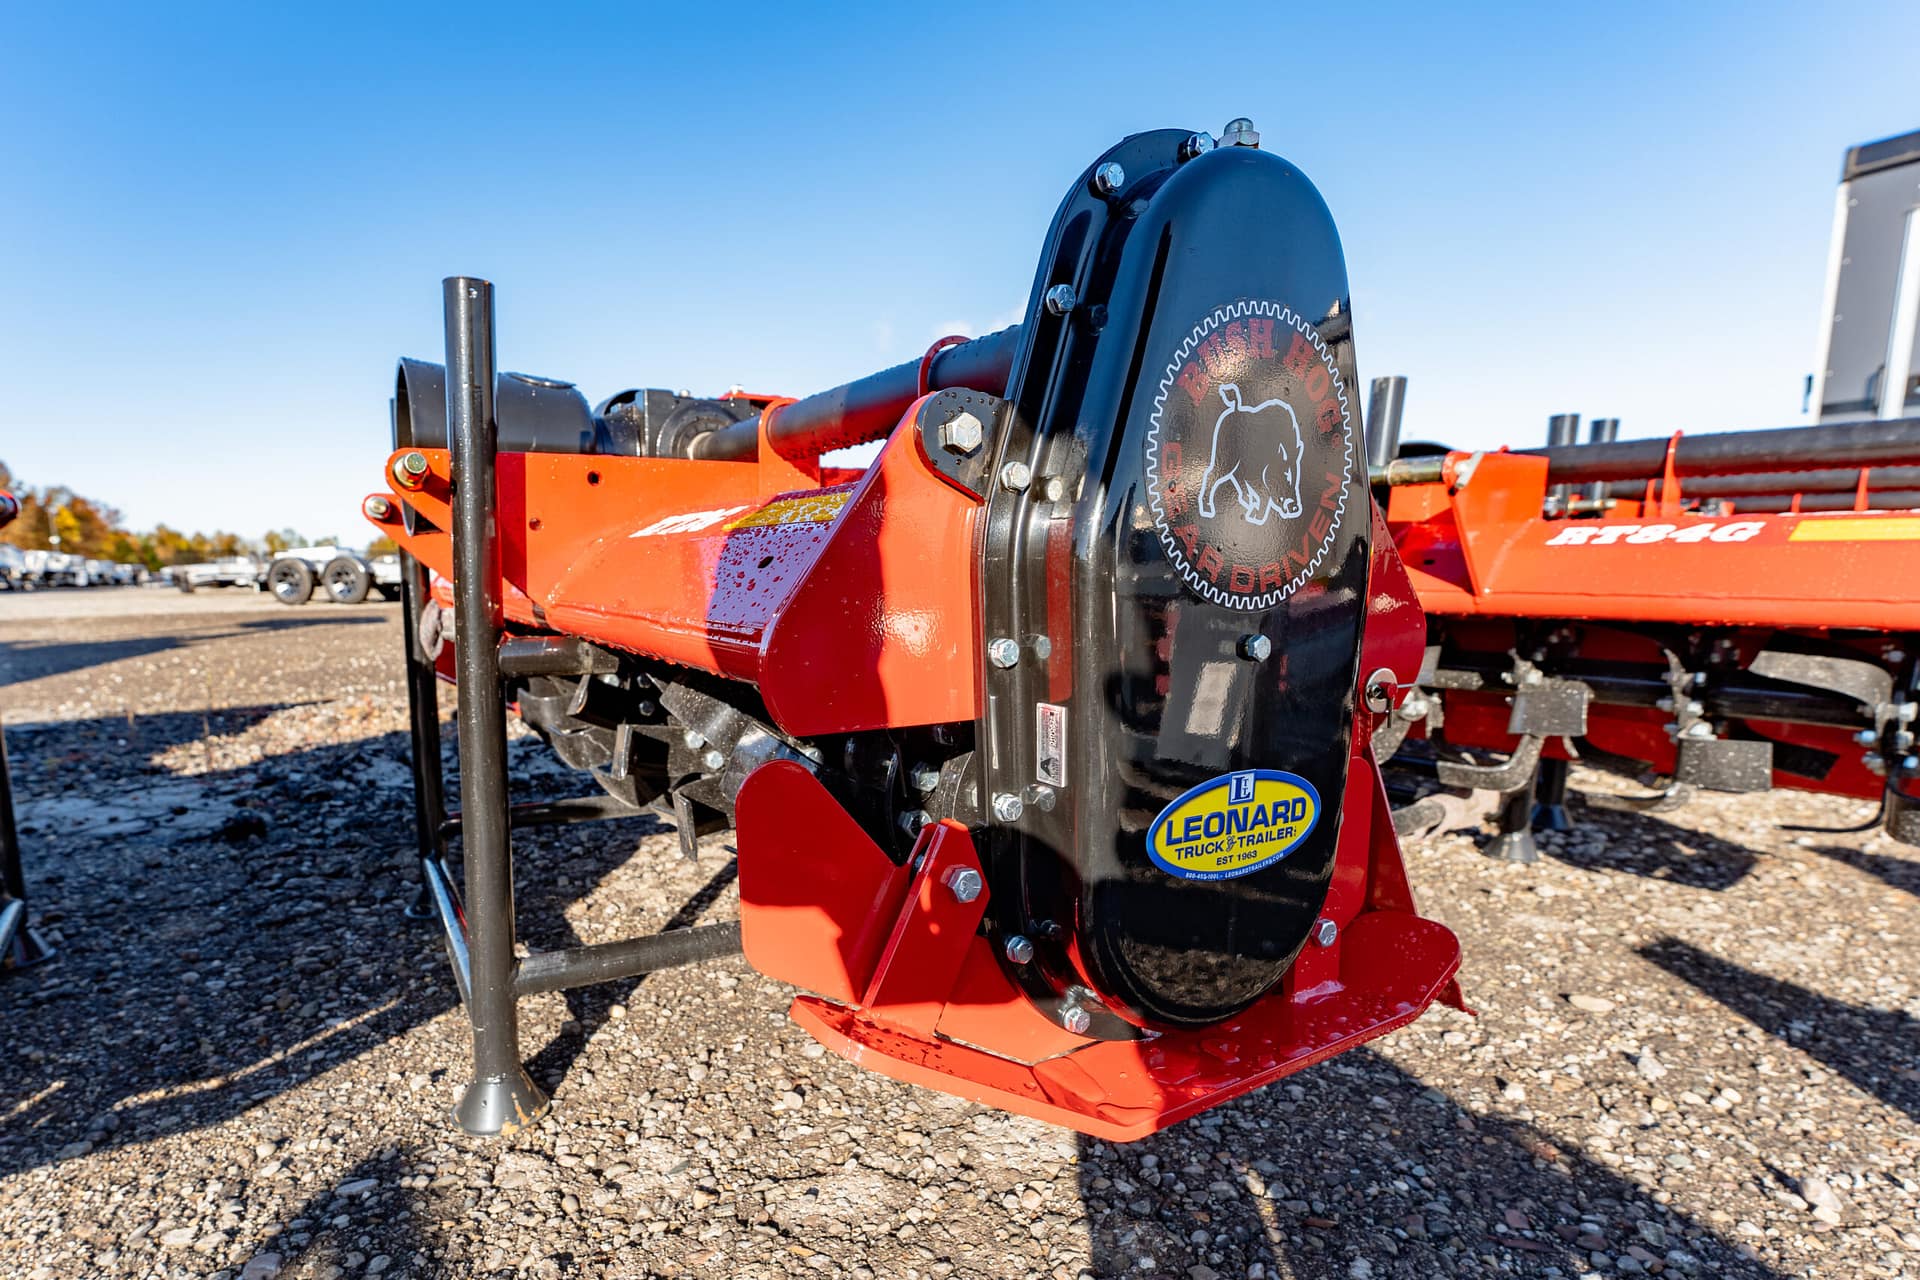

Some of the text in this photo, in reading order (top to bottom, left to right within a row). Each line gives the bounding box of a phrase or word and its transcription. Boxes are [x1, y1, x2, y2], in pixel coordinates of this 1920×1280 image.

[1178, 318, 1274, 406] BUSH
[1162, 441, 1342, 594] GEAR DRIVEN
[1546, 522, 1767, 545] RT84G
[1166, 797, 1307, 846] LEONARD
[1175, 840, 1225, 861] TRUCK
[1226, 835, 1237, 853] &
[1237, 830, 1293, 849] TRAILER
[1216, 850, 1258, 866] EST 1963
